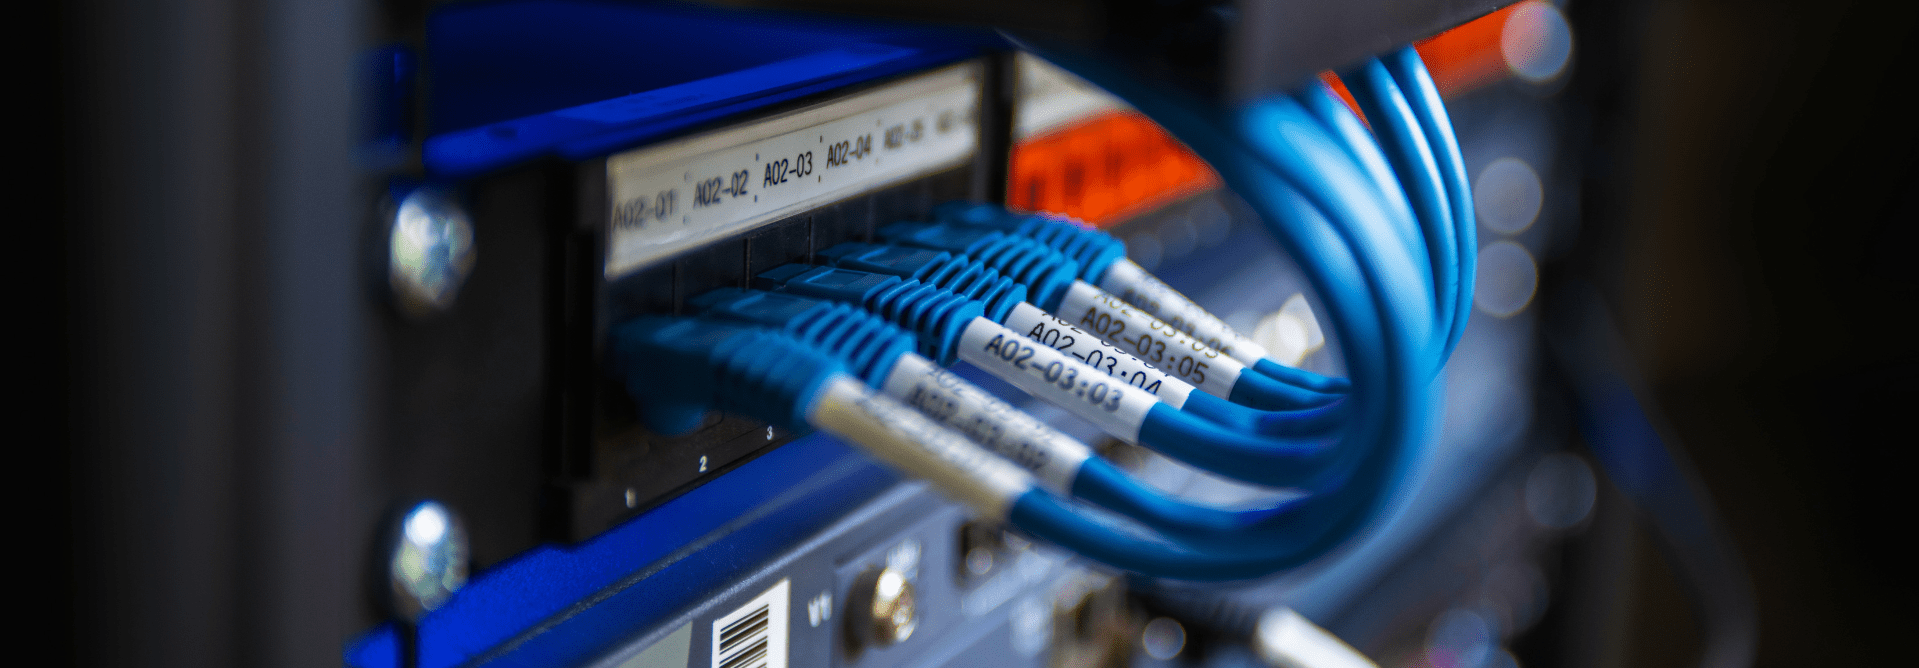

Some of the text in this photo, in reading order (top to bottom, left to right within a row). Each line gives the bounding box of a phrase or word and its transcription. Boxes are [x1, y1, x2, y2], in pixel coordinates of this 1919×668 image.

[612, 188, 677, 232] A02-01
[693, 170, 749, 210] A02-02
[763, 151, 813, 188] A02-03
[826, 133, 872, 169] A02-04
[984, 334, 1124, 413] A02-03:03
[1080, 307, 1209, 384] A02-03:05
[699, 455, 708, 472] 2
[766, 426, 773, 440] 3
